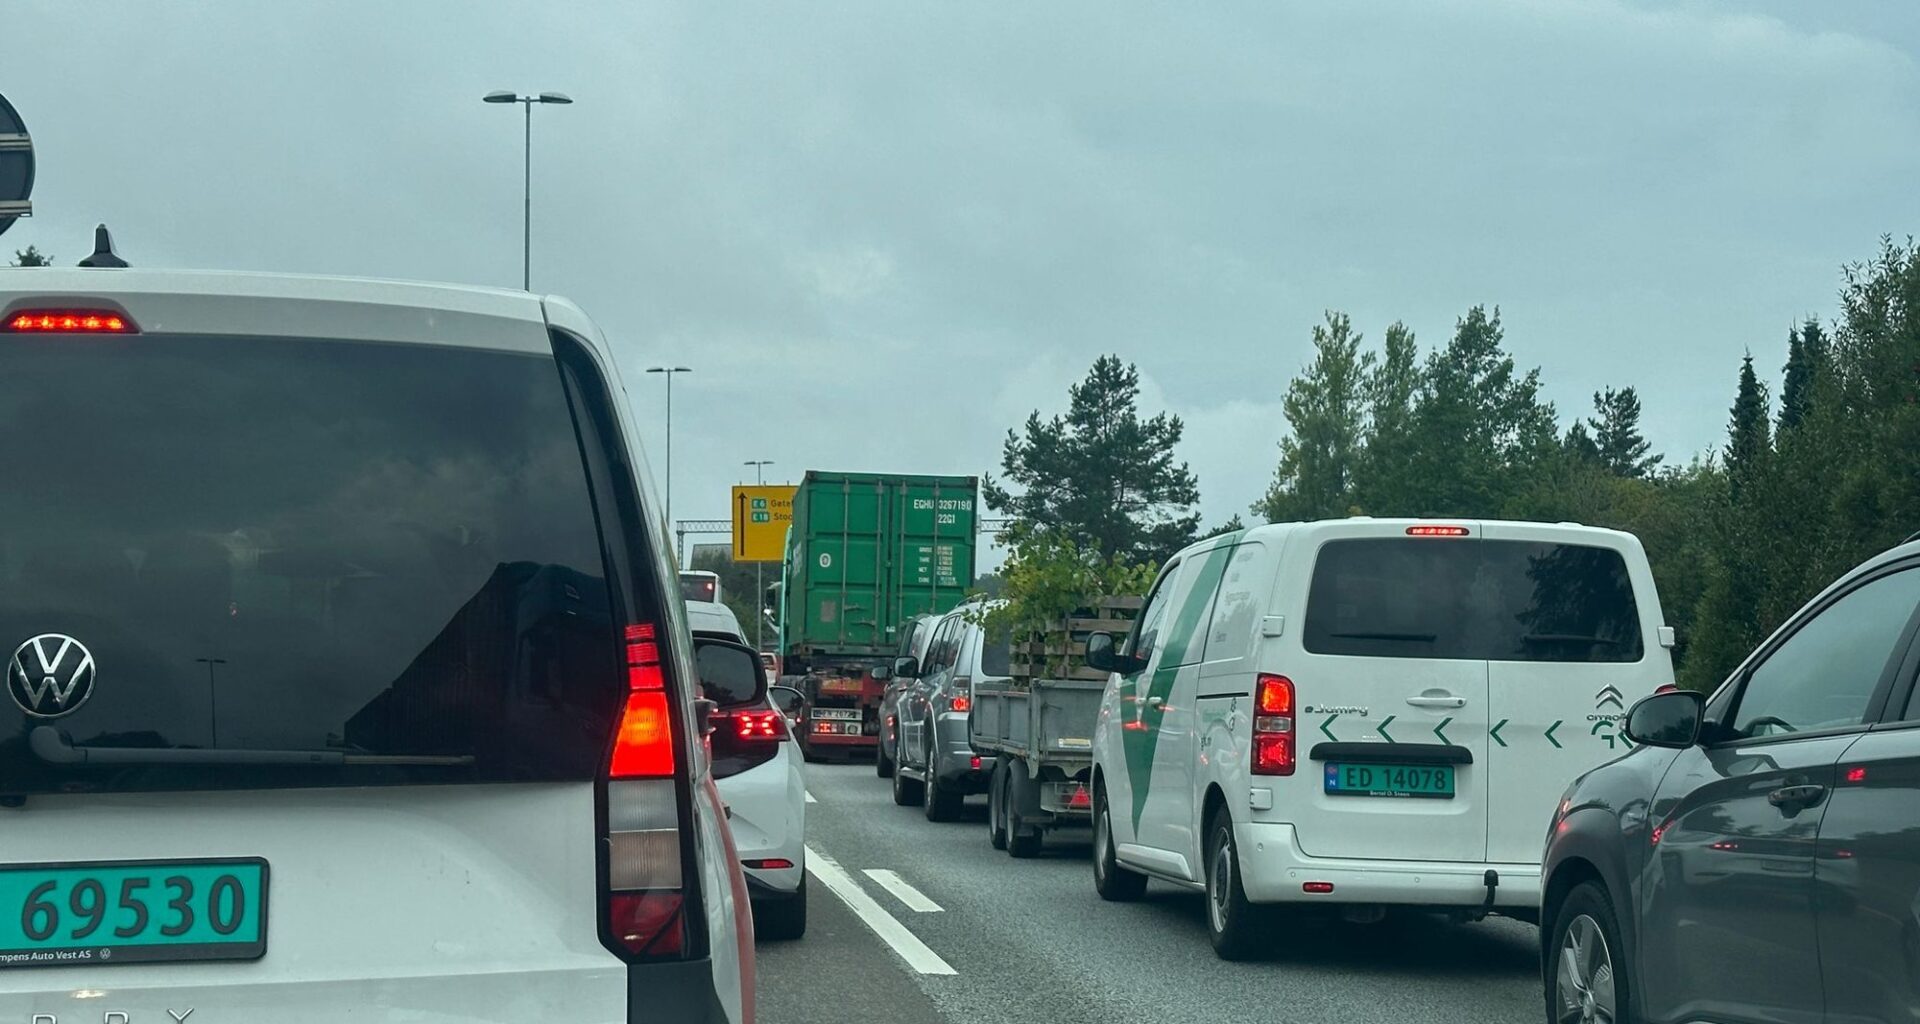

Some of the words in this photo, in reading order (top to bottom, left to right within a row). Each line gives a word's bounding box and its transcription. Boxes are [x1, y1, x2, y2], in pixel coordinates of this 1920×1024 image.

[914, 499, 934, 509] EGHU
[938, 514, 955, 524] 22G1
[1346, 768, 1373, 788] ED
[1383, 770, 1447, 790] 14078
[21, 874, 245, 941] 69530
[31, 952, 54, 960] Auto
[56, 951, 76, 959] Vest
[78, 950, 91, 958] AS
